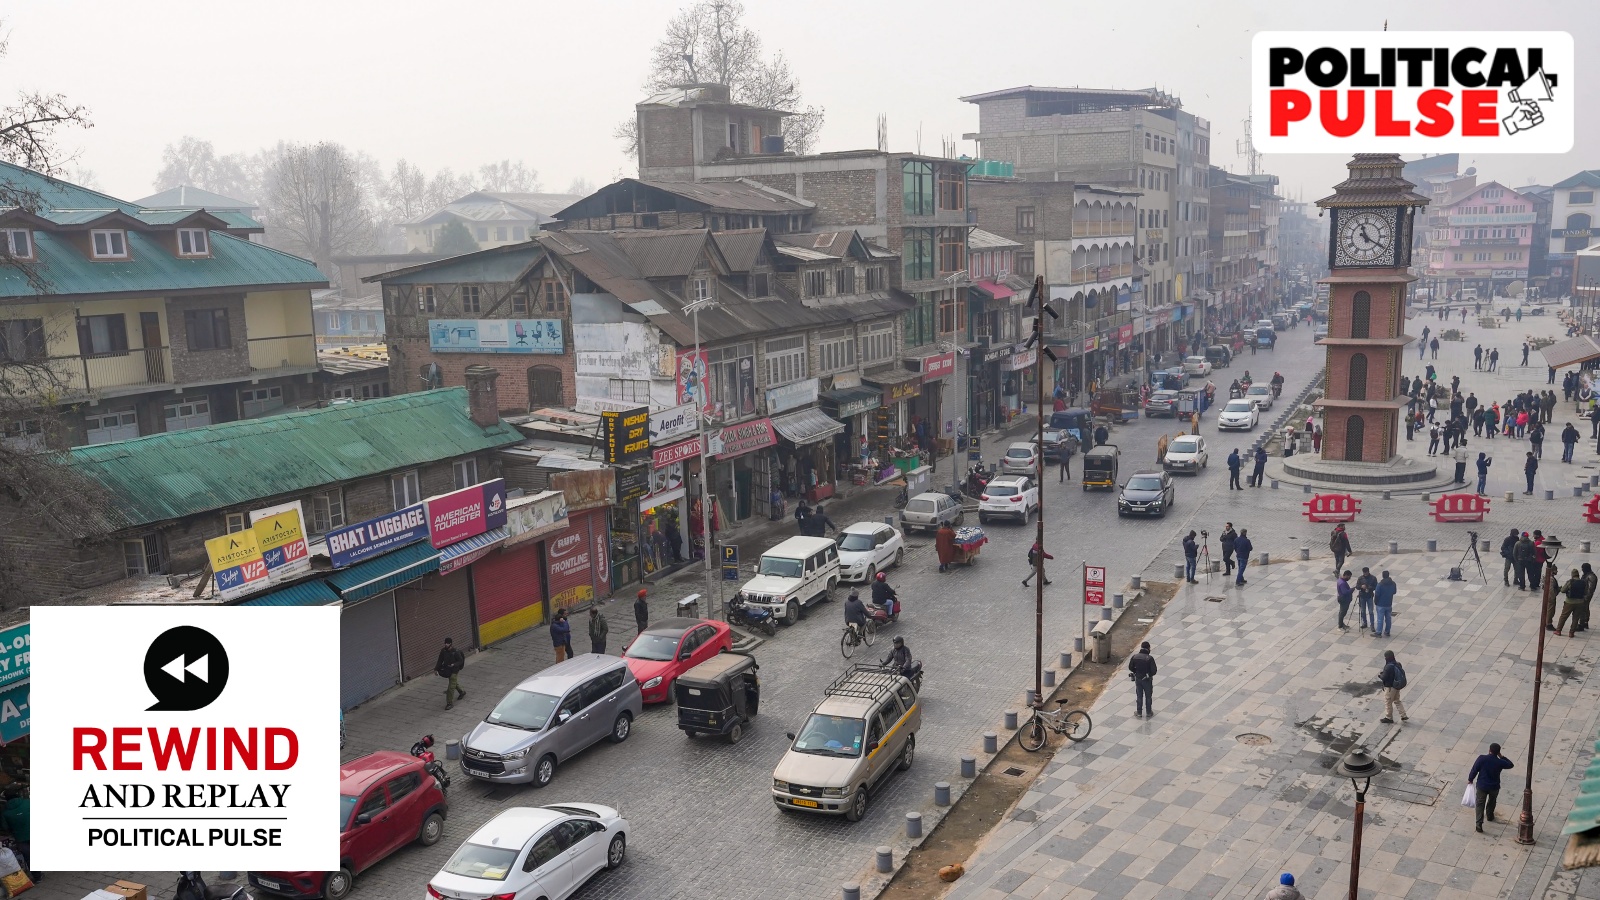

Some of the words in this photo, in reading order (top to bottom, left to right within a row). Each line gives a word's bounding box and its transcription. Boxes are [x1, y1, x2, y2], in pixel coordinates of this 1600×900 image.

[623, 412, 648, 427] NISHAT
[659, 414, 684, 432] Aerofit
[628, 427, 644, 439] DRY
[624, 439, 649, 454] FRUITS
[658, 449, 674, 464] ZEE
[434, 502, 481, 525] AMERICAN
[434, 510, 481, 533] TOURISTER
[262, 527, 297, 545] ARISTOCRAT
[329, 528, 366, 554] BHAT
[368, 508, 425, 540] LUGGAGE
[283, 540, 305, 559] VIP
[557, 533, 581, 549] RUPA
[217, 546, 256, 564] ARISTOCRAT
[726, 547, 734, 559] P
[242, 560, 266, 580] VIP
[551, 552, 589, 574] FRONTLINE
